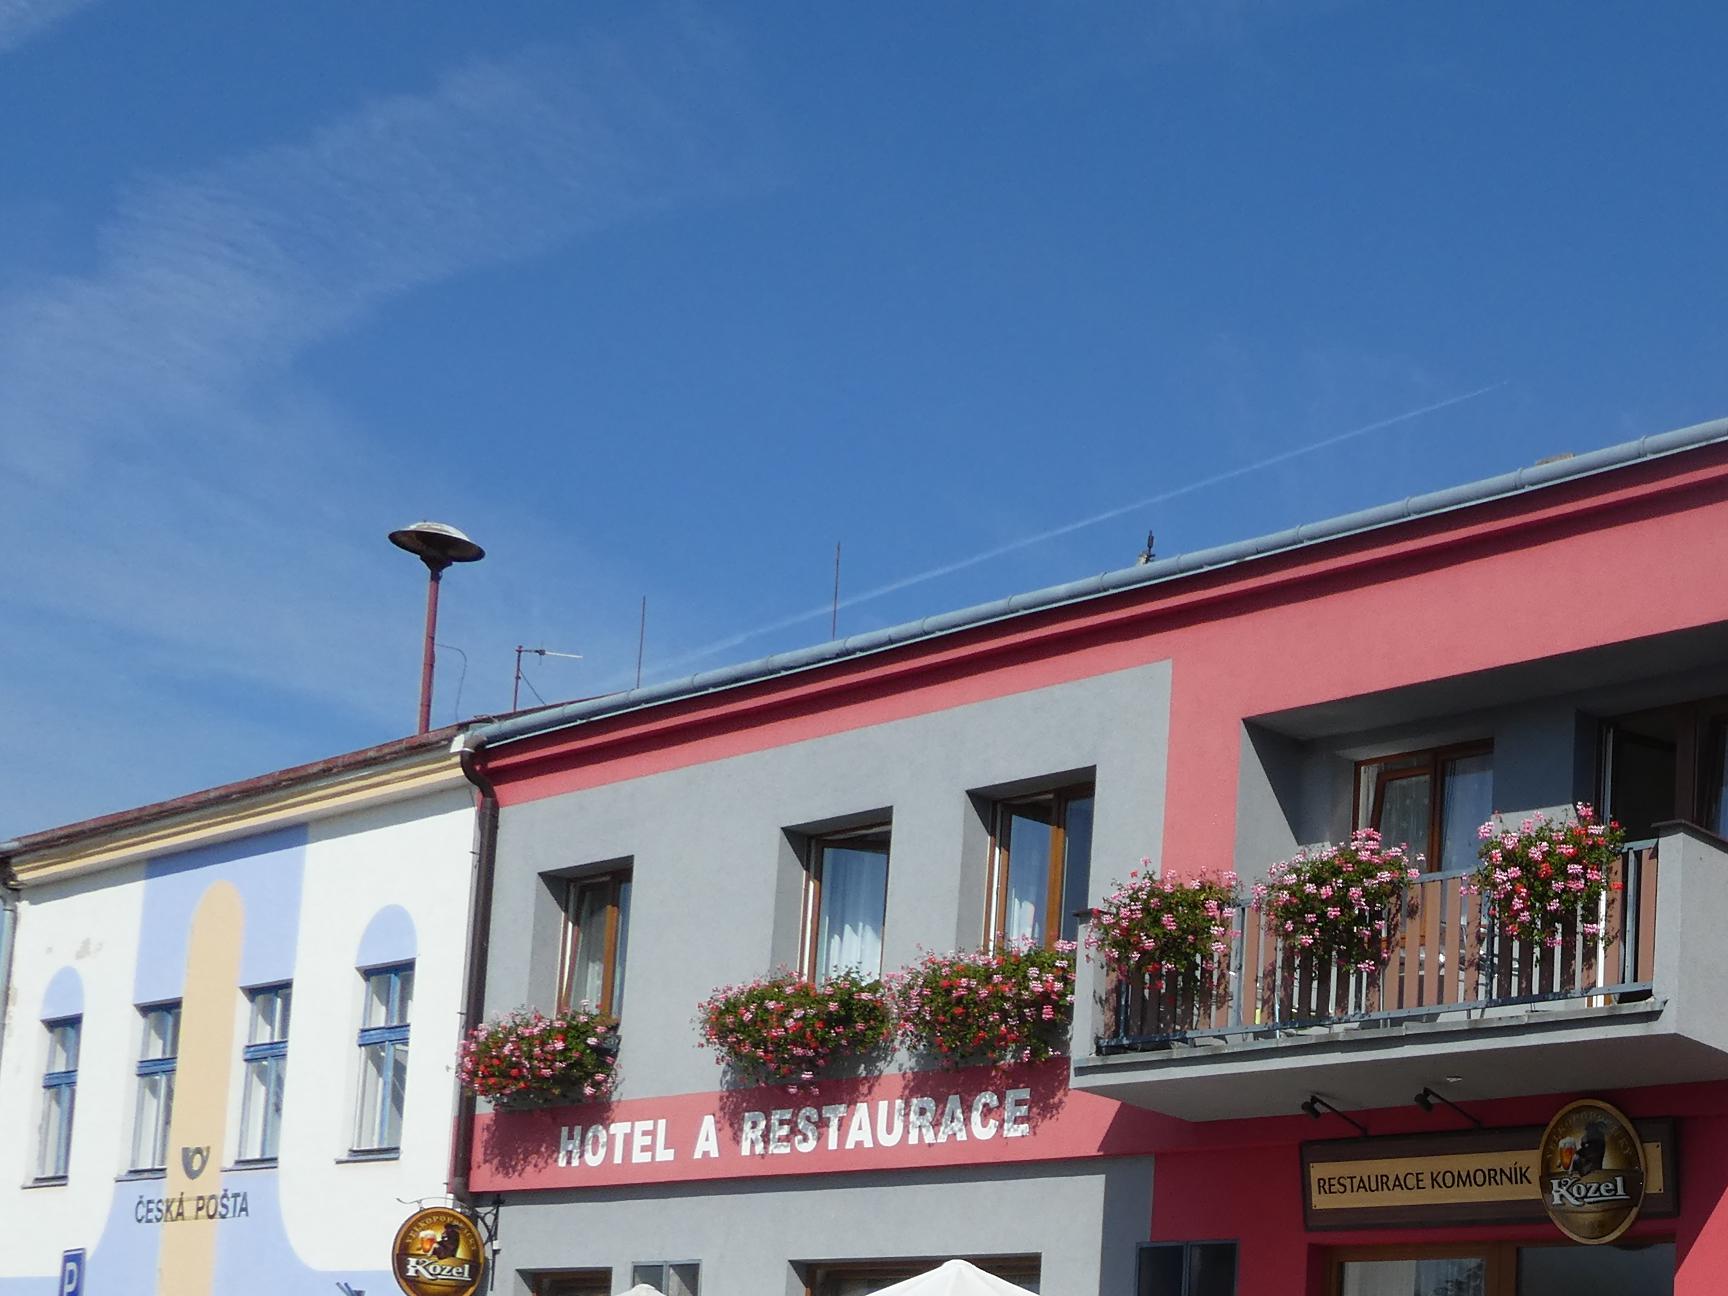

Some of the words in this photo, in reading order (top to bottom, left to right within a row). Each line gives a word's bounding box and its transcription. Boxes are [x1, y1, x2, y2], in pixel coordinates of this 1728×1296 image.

[557, 1118, 675, 1167] HOTEL
[694, 1115, 720, 1159] A
[741, 1088, 1031, 1156] RESTAURACE
[1317, 1172, 1426, 1195] RESTAURACE
[1430, 1161, 1532, 1189] KOMORNÍK
[1550, 1176, 1631, 1206] Kozel
[135, 1191, 184, 1224] ČESKÁ
[195, 1188, 249, 1220] POŠTA
[406, 1257, 472, 1280] Kozel
